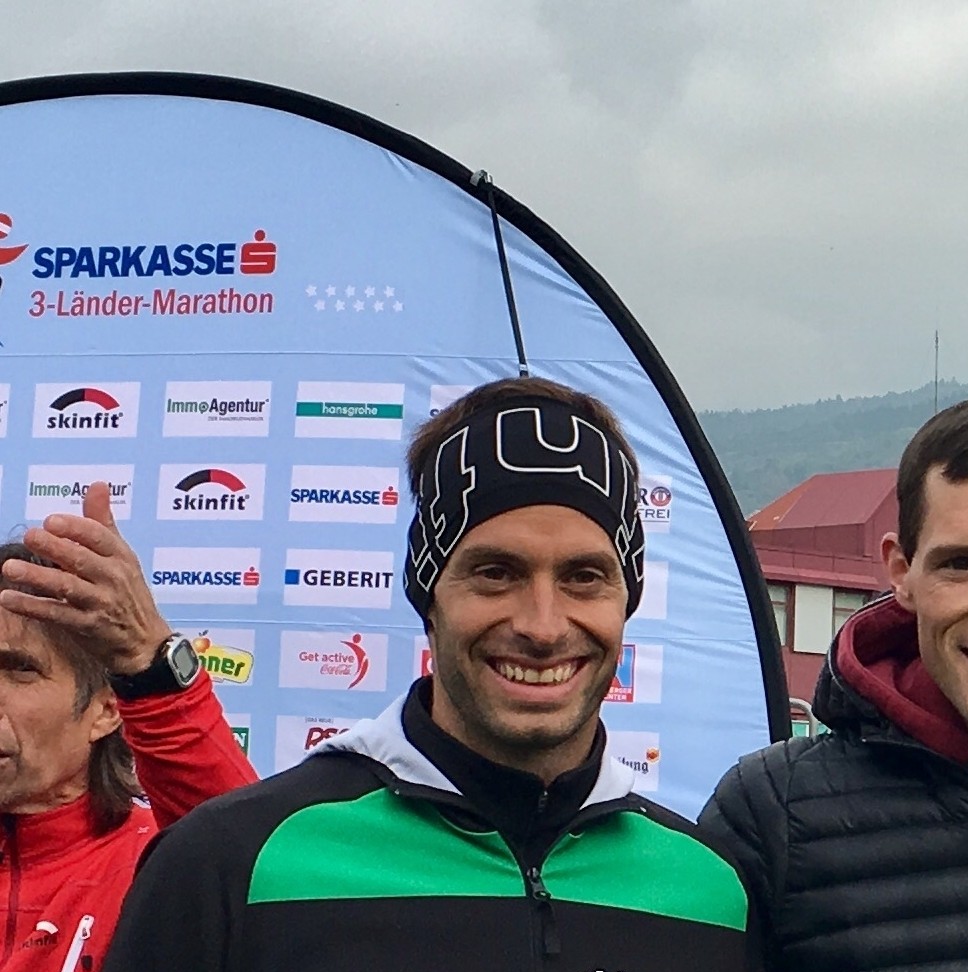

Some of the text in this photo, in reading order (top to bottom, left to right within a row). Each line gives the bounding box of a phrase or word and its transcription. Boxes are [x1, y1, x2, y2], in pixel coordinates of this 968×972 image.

[32, 243, 236, 278] SPARKASSE
[29, 287, 273, 317] 3-Länder-Marathon
[322, 402, 378, 417] hansgrohe
[290, 488, 381, 505] SPARKASSE
[152, 571, 242, 586] SPARKASSE
[303, 569, 394, 588] GEBERIT
[299, 651, 355, 663] Get active
